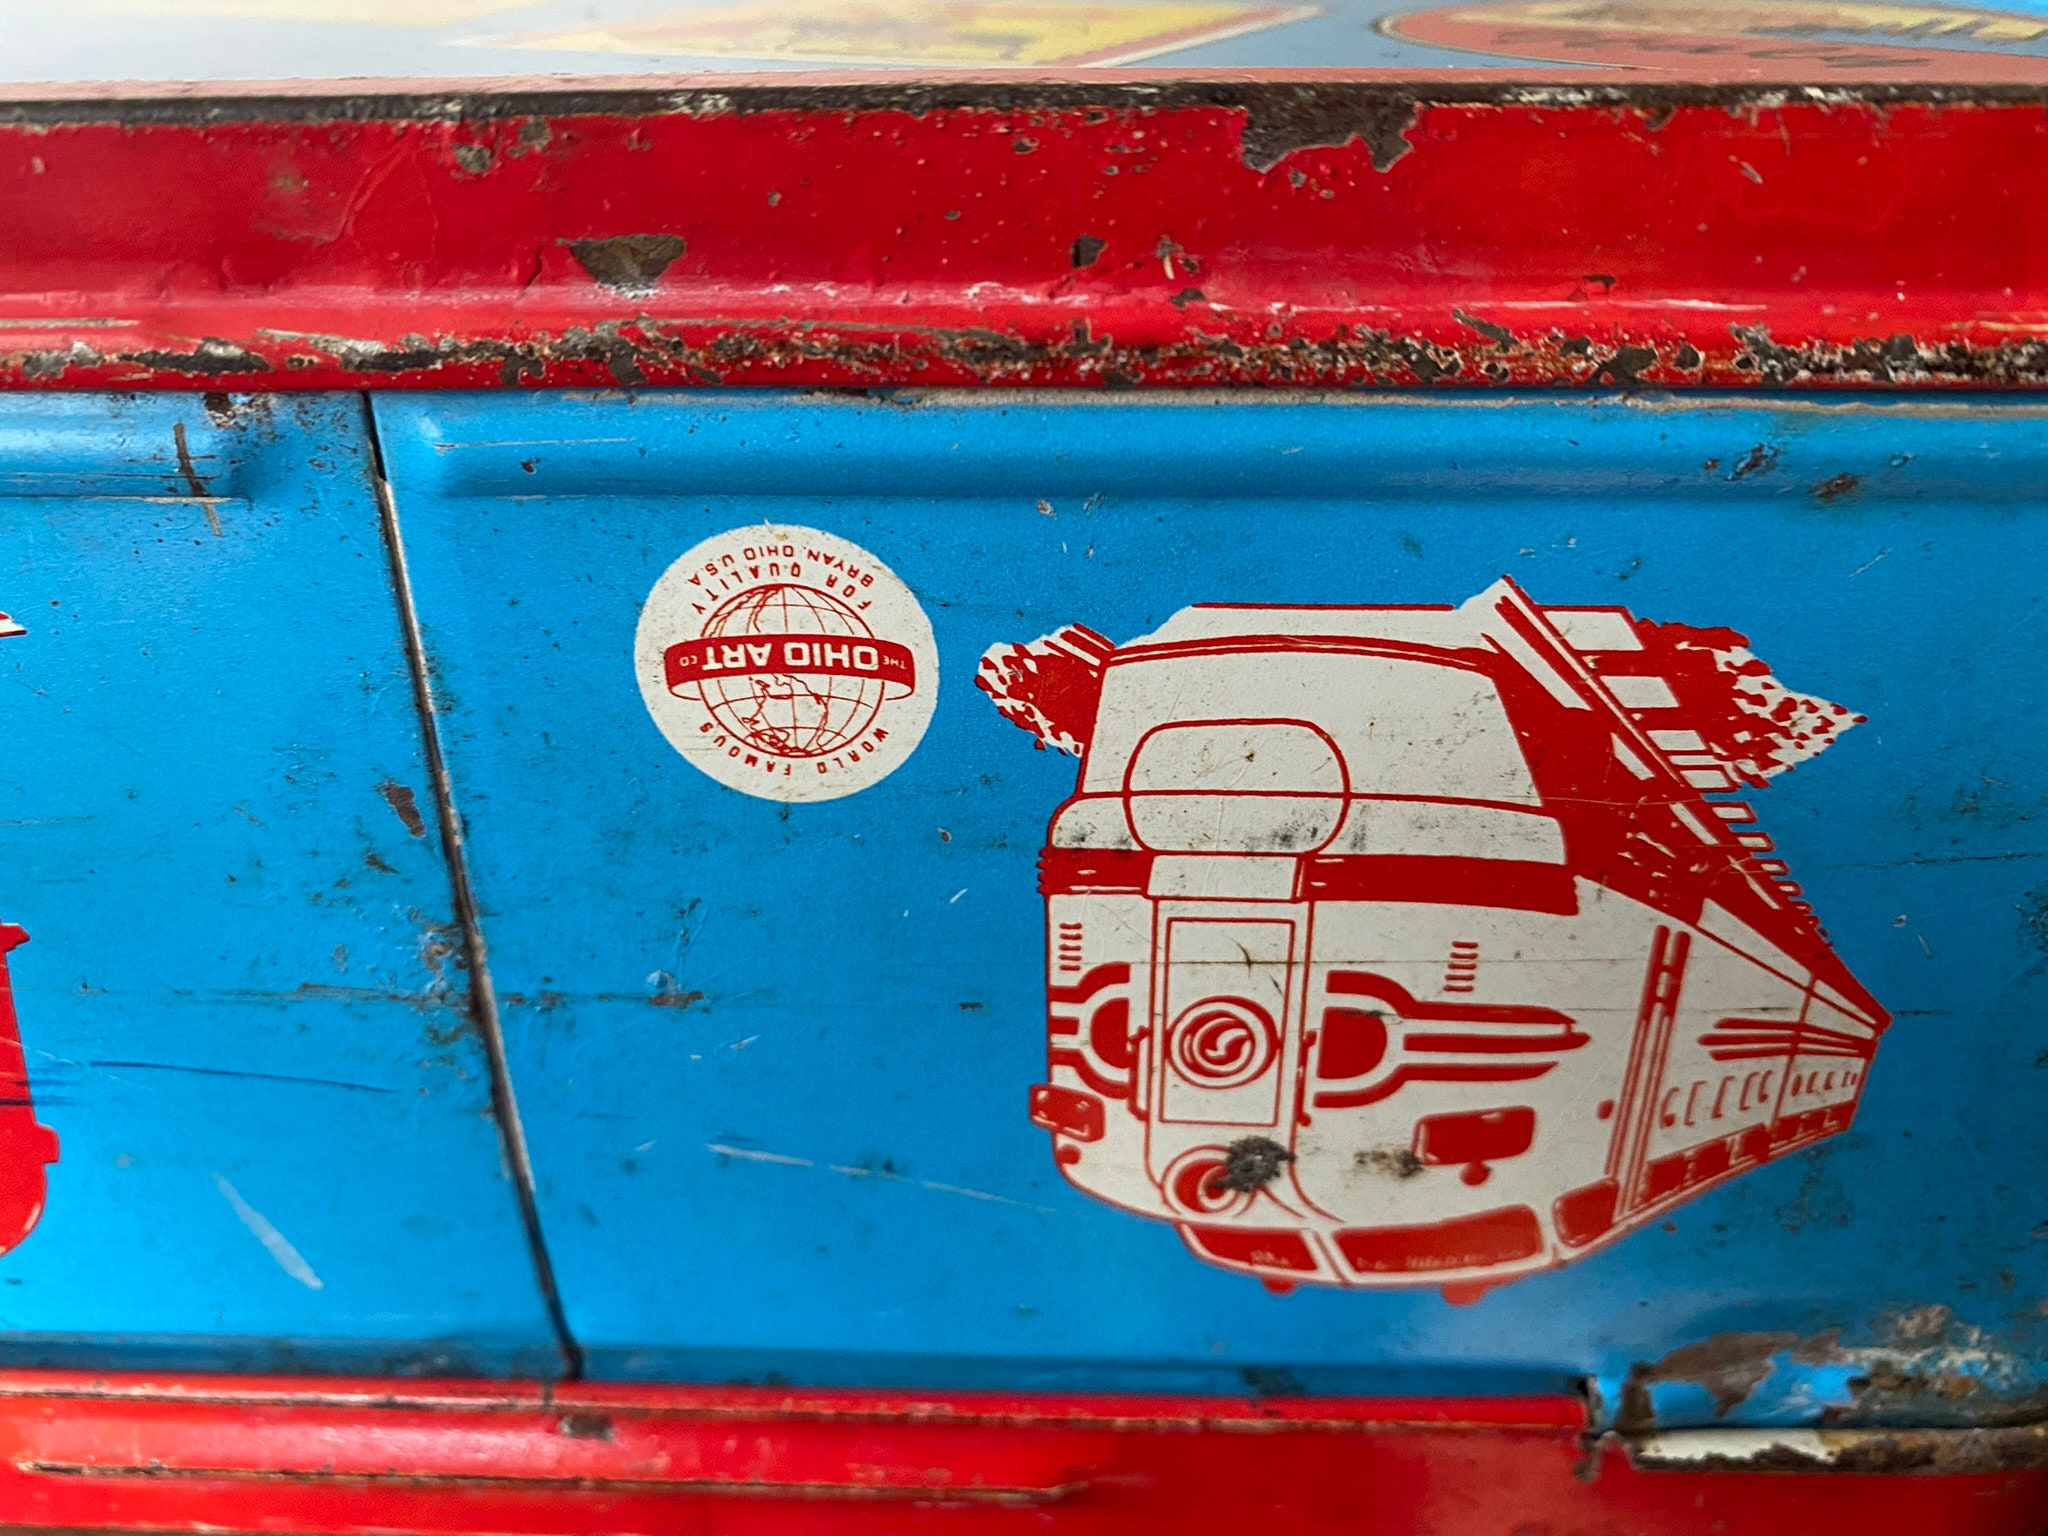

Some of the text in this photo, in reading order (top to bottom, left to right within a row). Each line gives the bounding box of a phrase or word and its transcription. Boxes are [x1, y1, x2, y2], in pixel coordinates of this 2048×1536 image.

[743, 545, 795, 560] OHIO
[691, 562, 873, 614] FOR QUALITY
[702, 643, 772, 670] ART
[784, 642, 879, 670] OHIO
[883, 656, 907, 669] THE
[699, 721, 889, 775] WORLD FAMOUS
